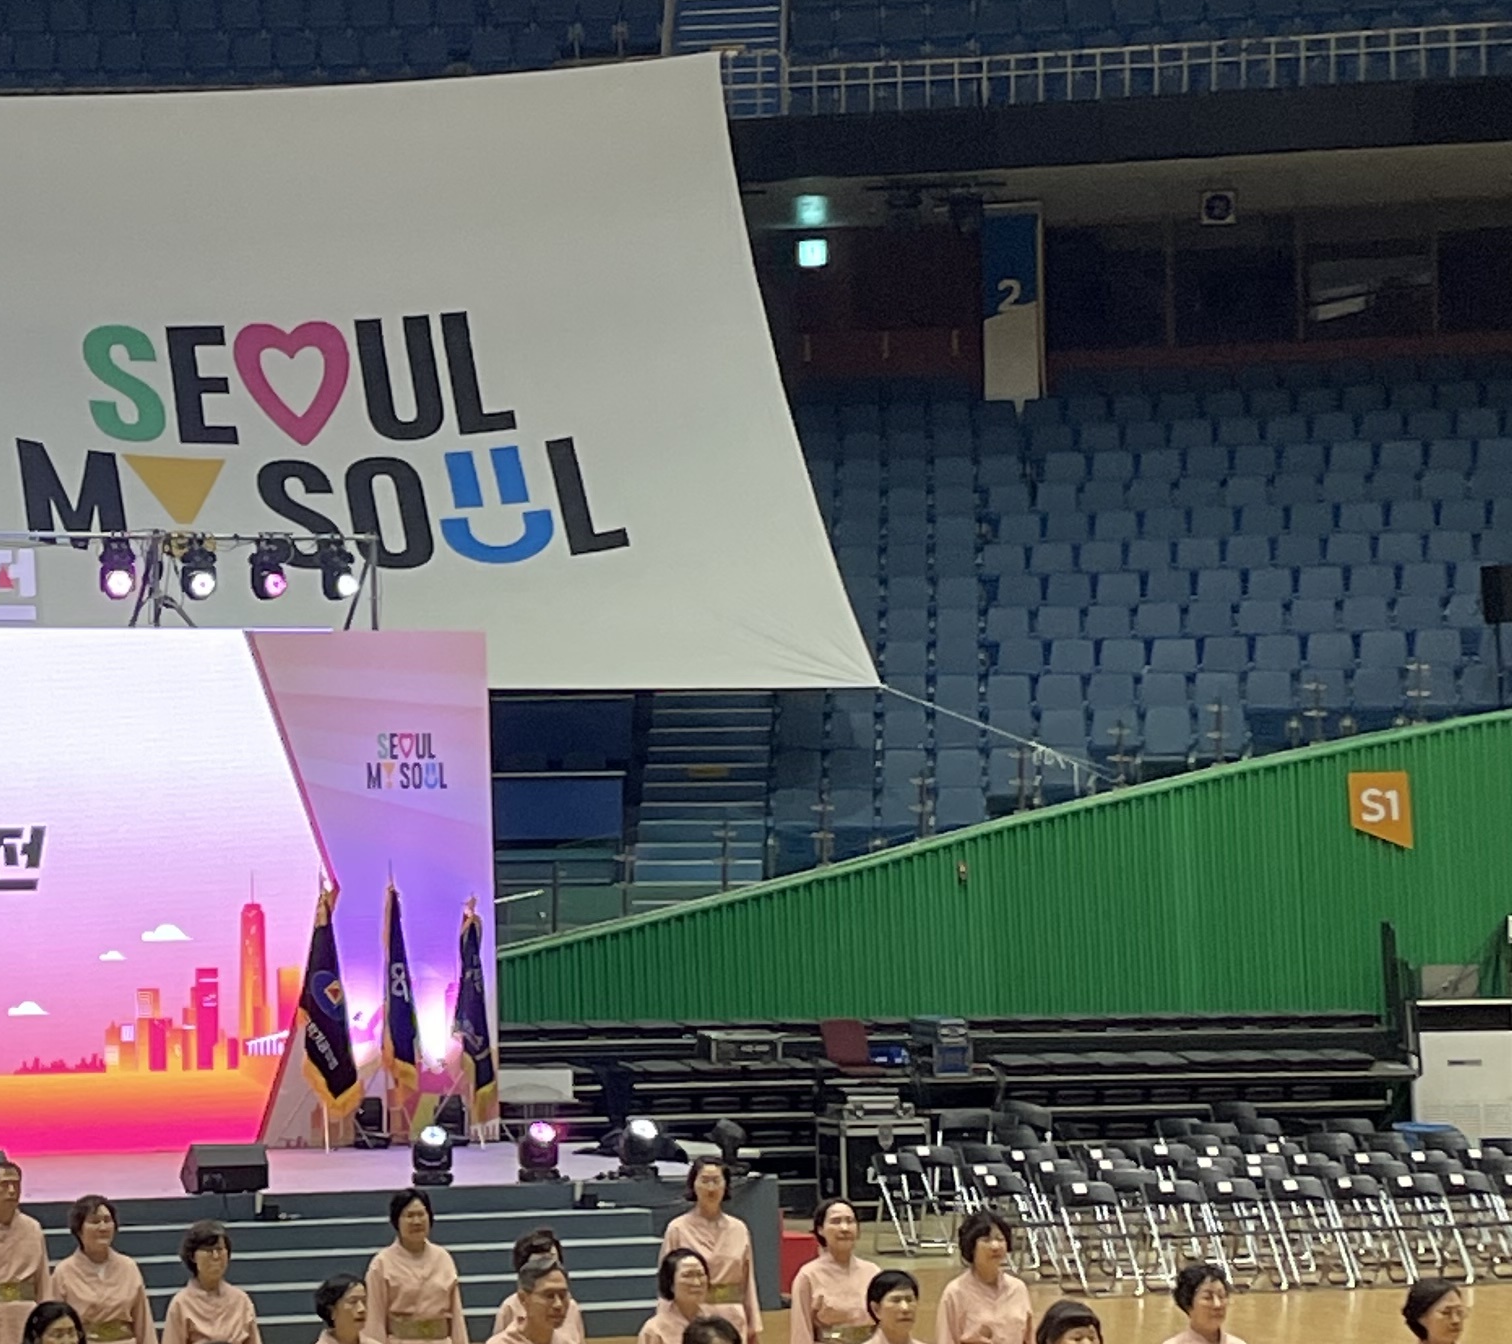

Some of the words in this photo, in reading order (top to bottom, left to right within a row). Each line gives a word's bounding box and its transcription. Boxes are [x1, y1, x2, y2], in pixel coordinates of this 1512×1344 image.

[997, 278, 1025, 312] 2
[257, 436, 630, 570] SOUL
[400, 762, 448, 790] SOUL
[1360, 787, 1400, 823] S1
